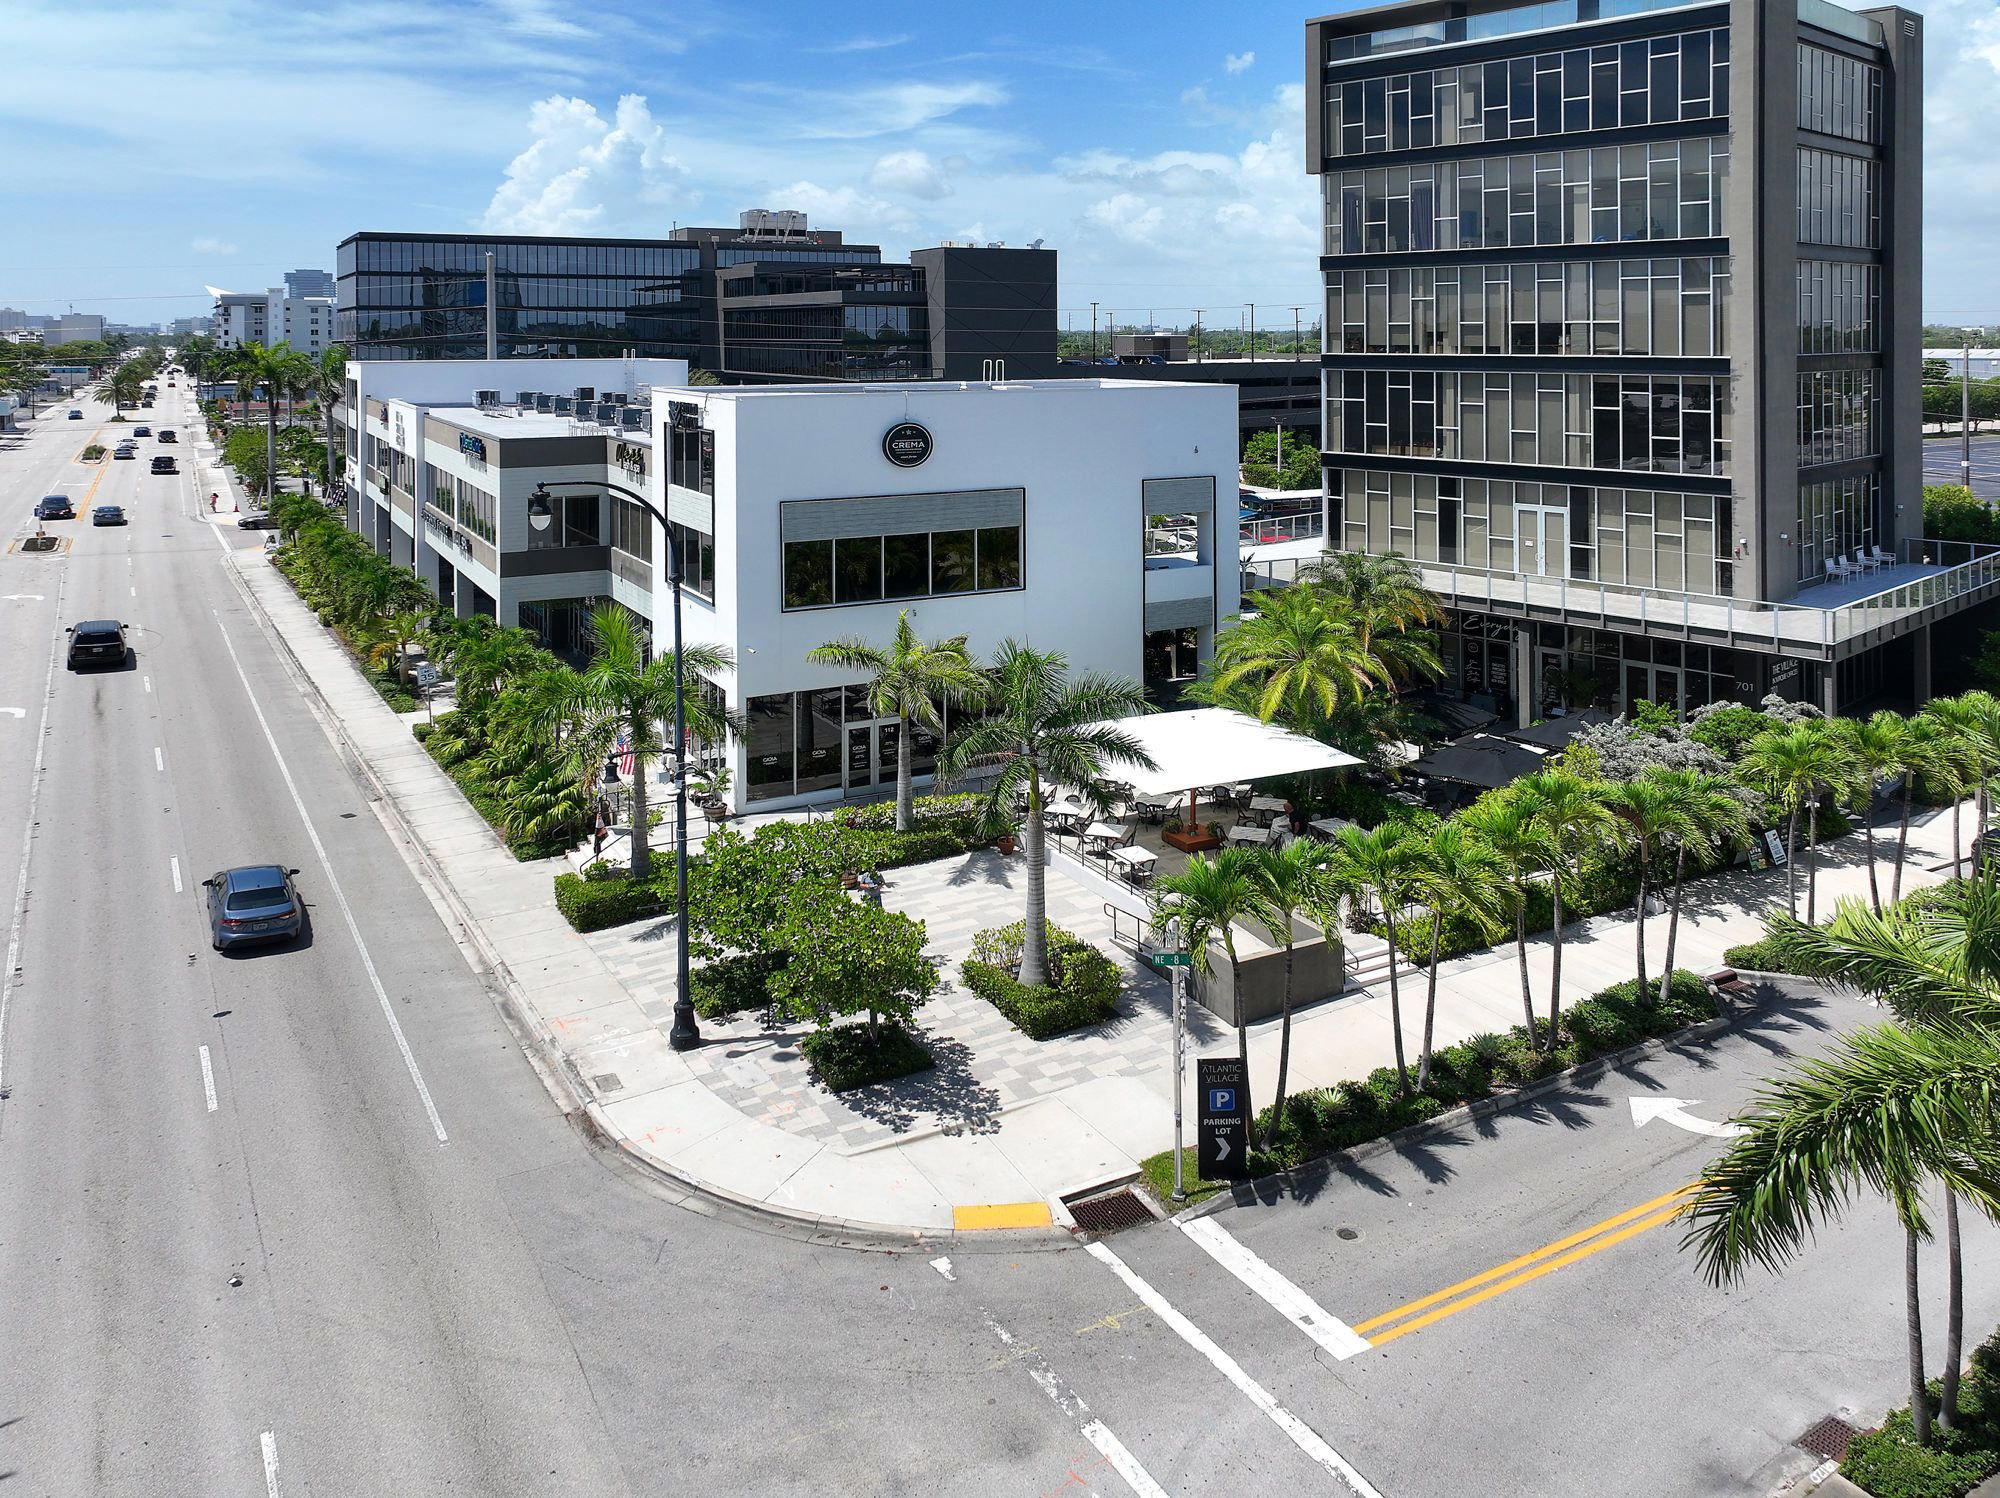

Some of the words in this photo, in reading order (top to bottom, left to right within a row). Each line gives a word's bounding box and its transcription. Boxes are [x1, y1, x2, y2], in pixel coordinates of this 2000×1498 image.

[892, 441, 925, 449] CREMA
[1736, 681, 1754, 692] 701
[1155, 955, 1165, 964] NE
[1174, 955, 1180, 964] 8
[1202, 1064, 1242, 1073] ATLANTIC
[1205, 1074, 1239, 1083] VILLAGE
[1216, 1091, 1230, 1108] P
[1203, 1118, 1241, 1126] PARKING
[1215, 1127, 1232, 1135] LOT
